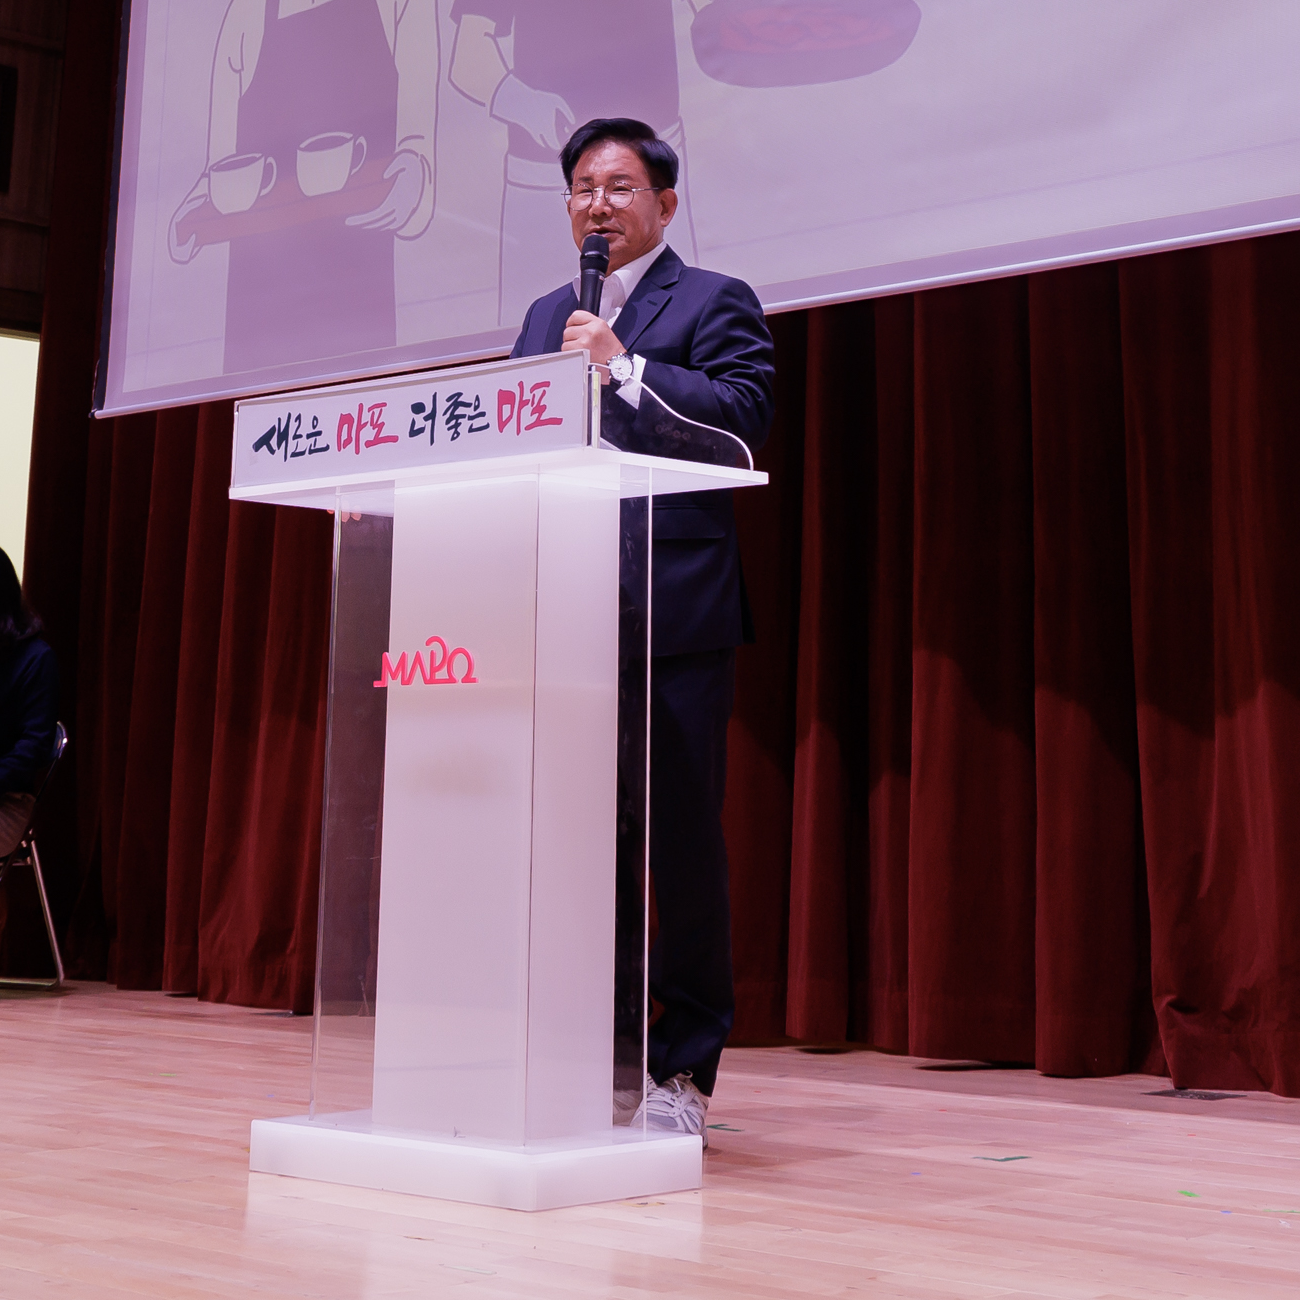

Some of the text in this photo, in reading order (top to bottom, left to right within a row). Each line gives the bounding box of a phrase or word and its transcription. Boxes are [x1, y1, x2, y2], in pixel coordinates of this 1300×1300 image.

[252, 411, 331, 462] 새로운
[336, 402, 400, 455] 마포
[497, 380, 564, 436] 마포
[373, 635, 479, 688] MAPO
